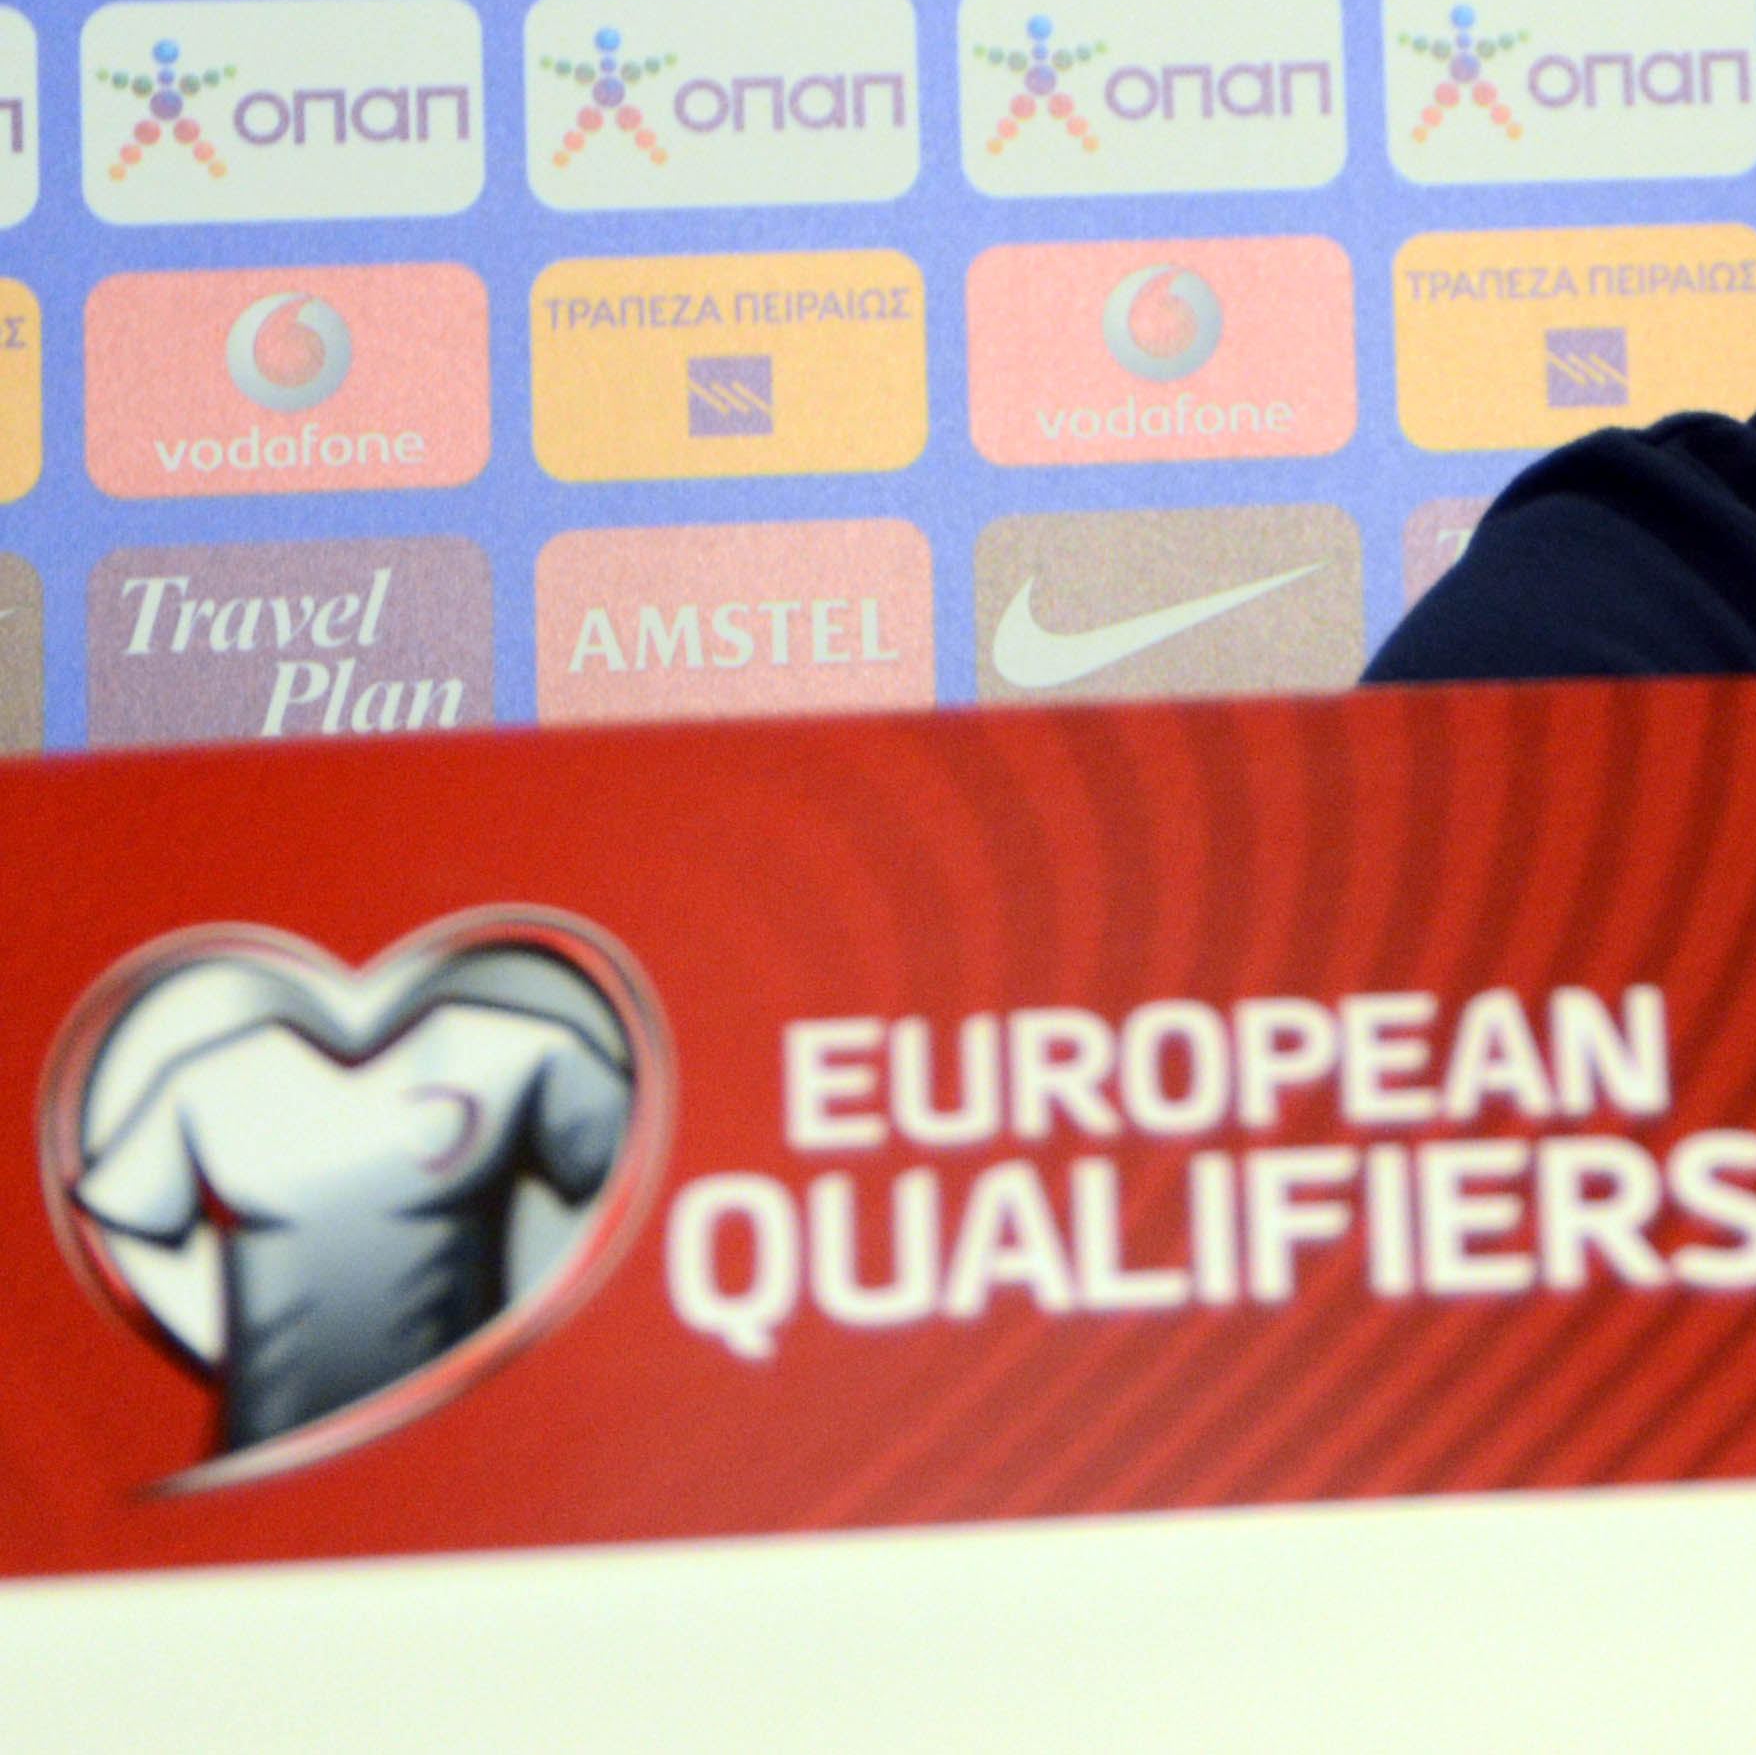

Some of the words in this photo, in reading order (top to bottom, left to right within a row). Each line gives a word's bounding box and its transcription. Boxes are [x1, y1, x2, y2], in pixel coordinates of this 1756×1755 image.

[543, 292, 724, 331] ΤΡΑΠΕΖΑ
[733, 287, 912, 326] ΠΕΙΡΑΙΩΣ
[1406, 266, 1579, 303] ΤΡΑΠΕΖΑ
[1036, 392, 1293, 440] vodafone
[155, 423, 425, 473] vodafone
[121, 567, 392, 655] Travel
[567, 597, 900, 673] AMSTEL
[260, 657, 465, 737] Plan
[781, 985, 1672, 1155] EUROPEAN
